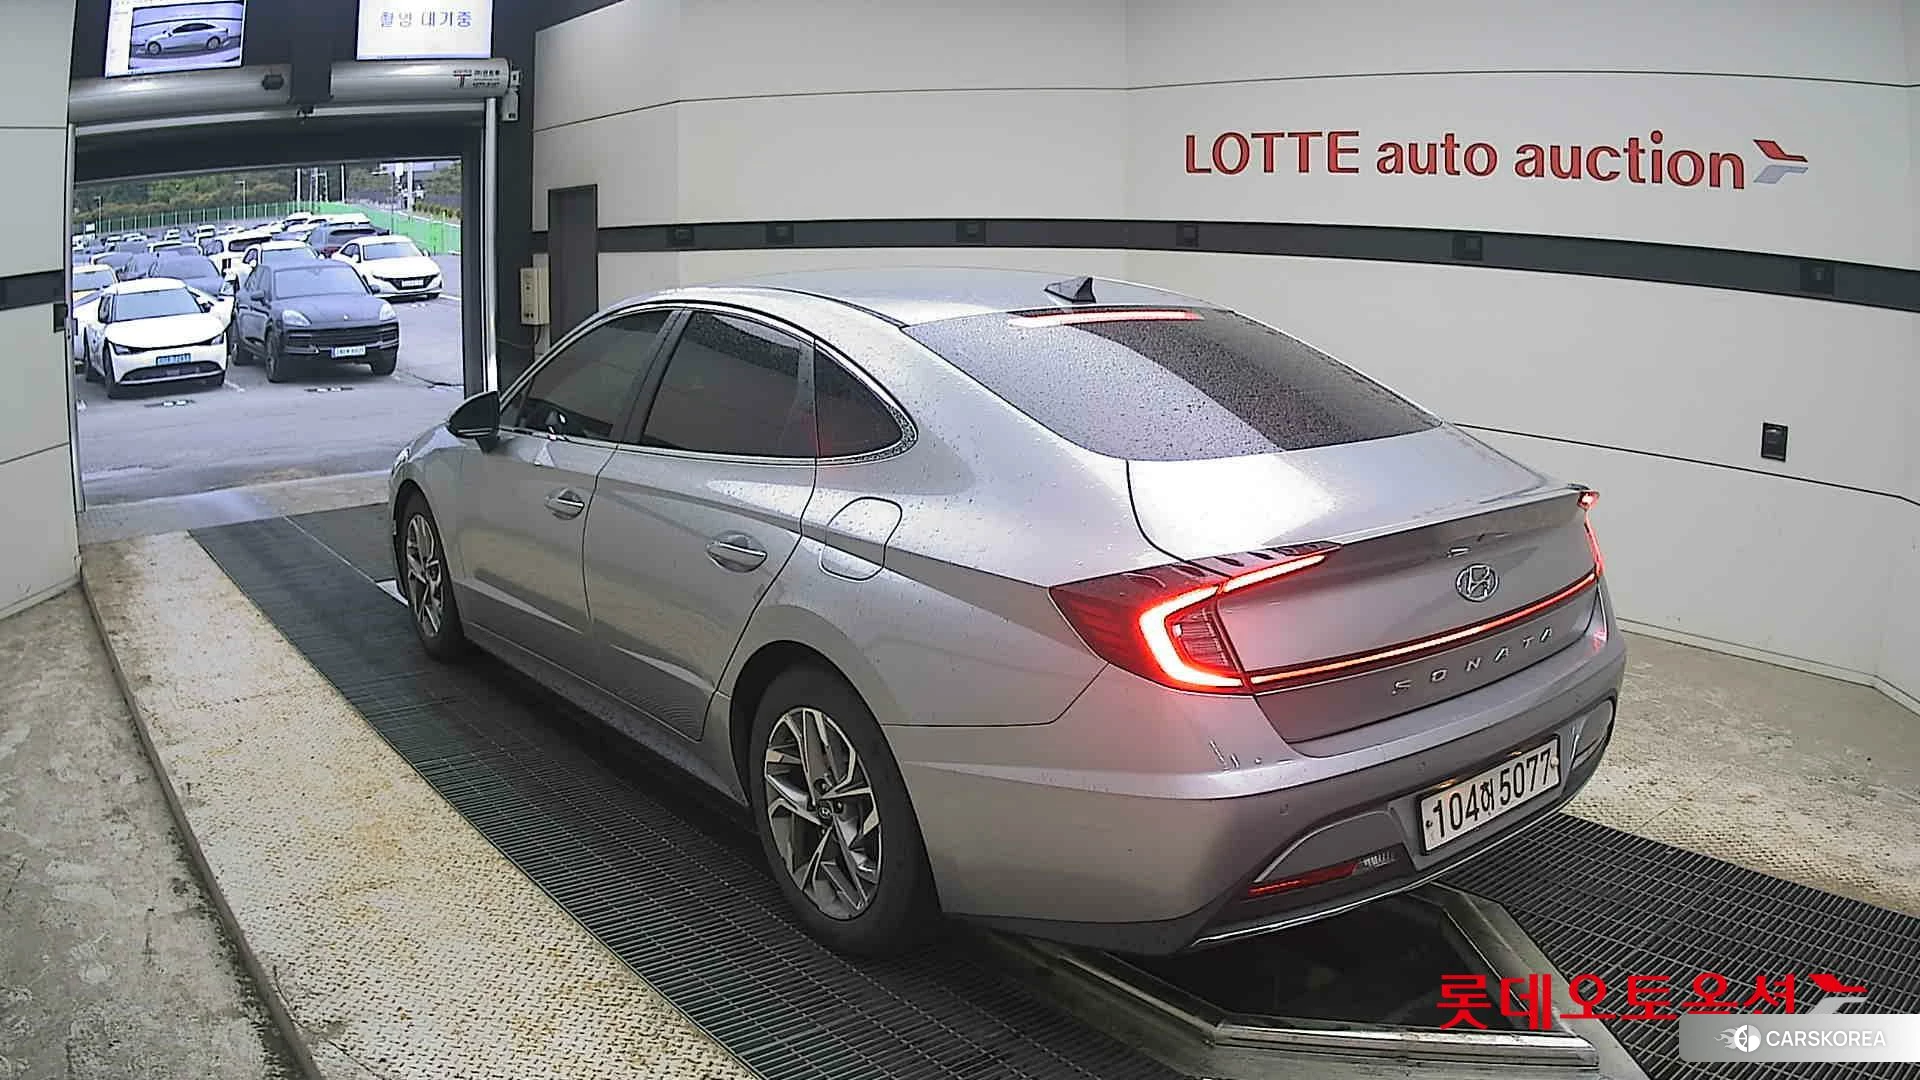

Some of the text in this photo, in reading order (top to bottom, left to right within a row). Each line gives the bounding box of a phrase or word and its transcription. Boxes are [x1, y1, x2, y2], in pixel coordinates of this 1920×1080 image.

[422, 11, 472, 28] 대기중
[1185, 130, 1743, 189] LOTTE auto auction
[1391, 627, 1553, 695] SONATA
